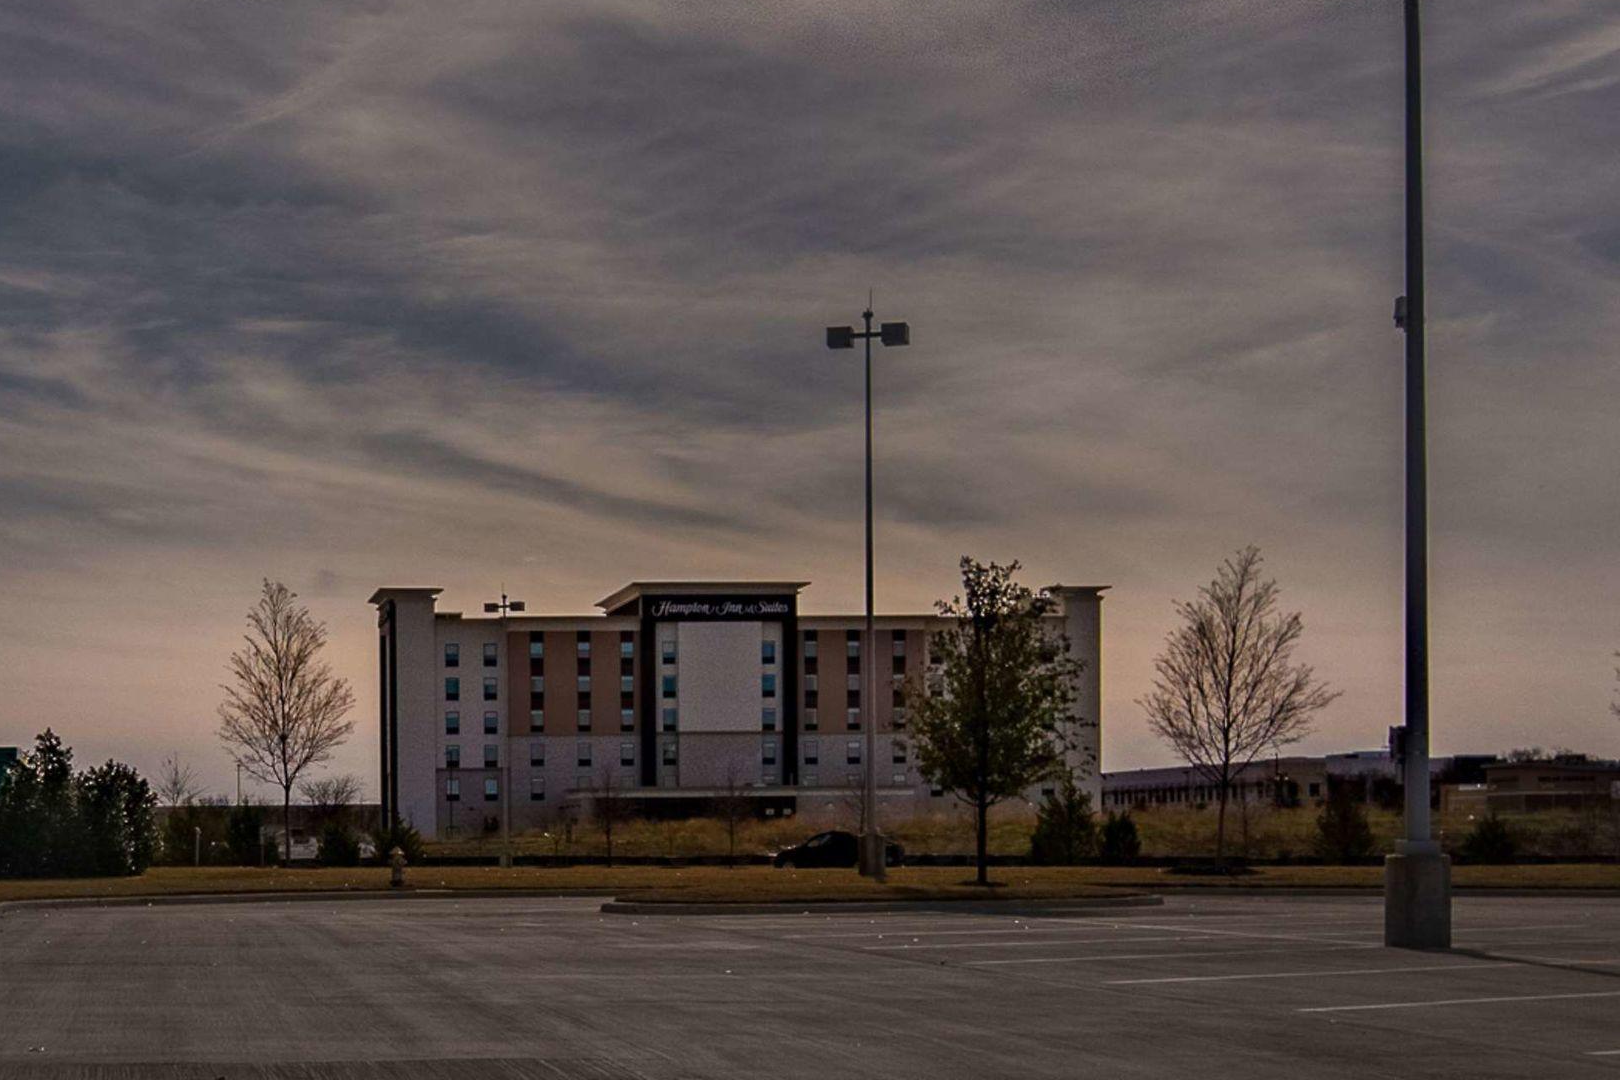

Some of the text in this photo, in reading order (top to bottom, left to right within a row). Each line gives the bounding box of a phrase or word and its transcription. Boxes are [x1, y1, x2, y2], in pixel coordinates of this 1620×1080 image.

[651, 600, 715, 617] Hampton
[716, 601, 743, 616] Inn
[755, 600, 788, 614] Suites
